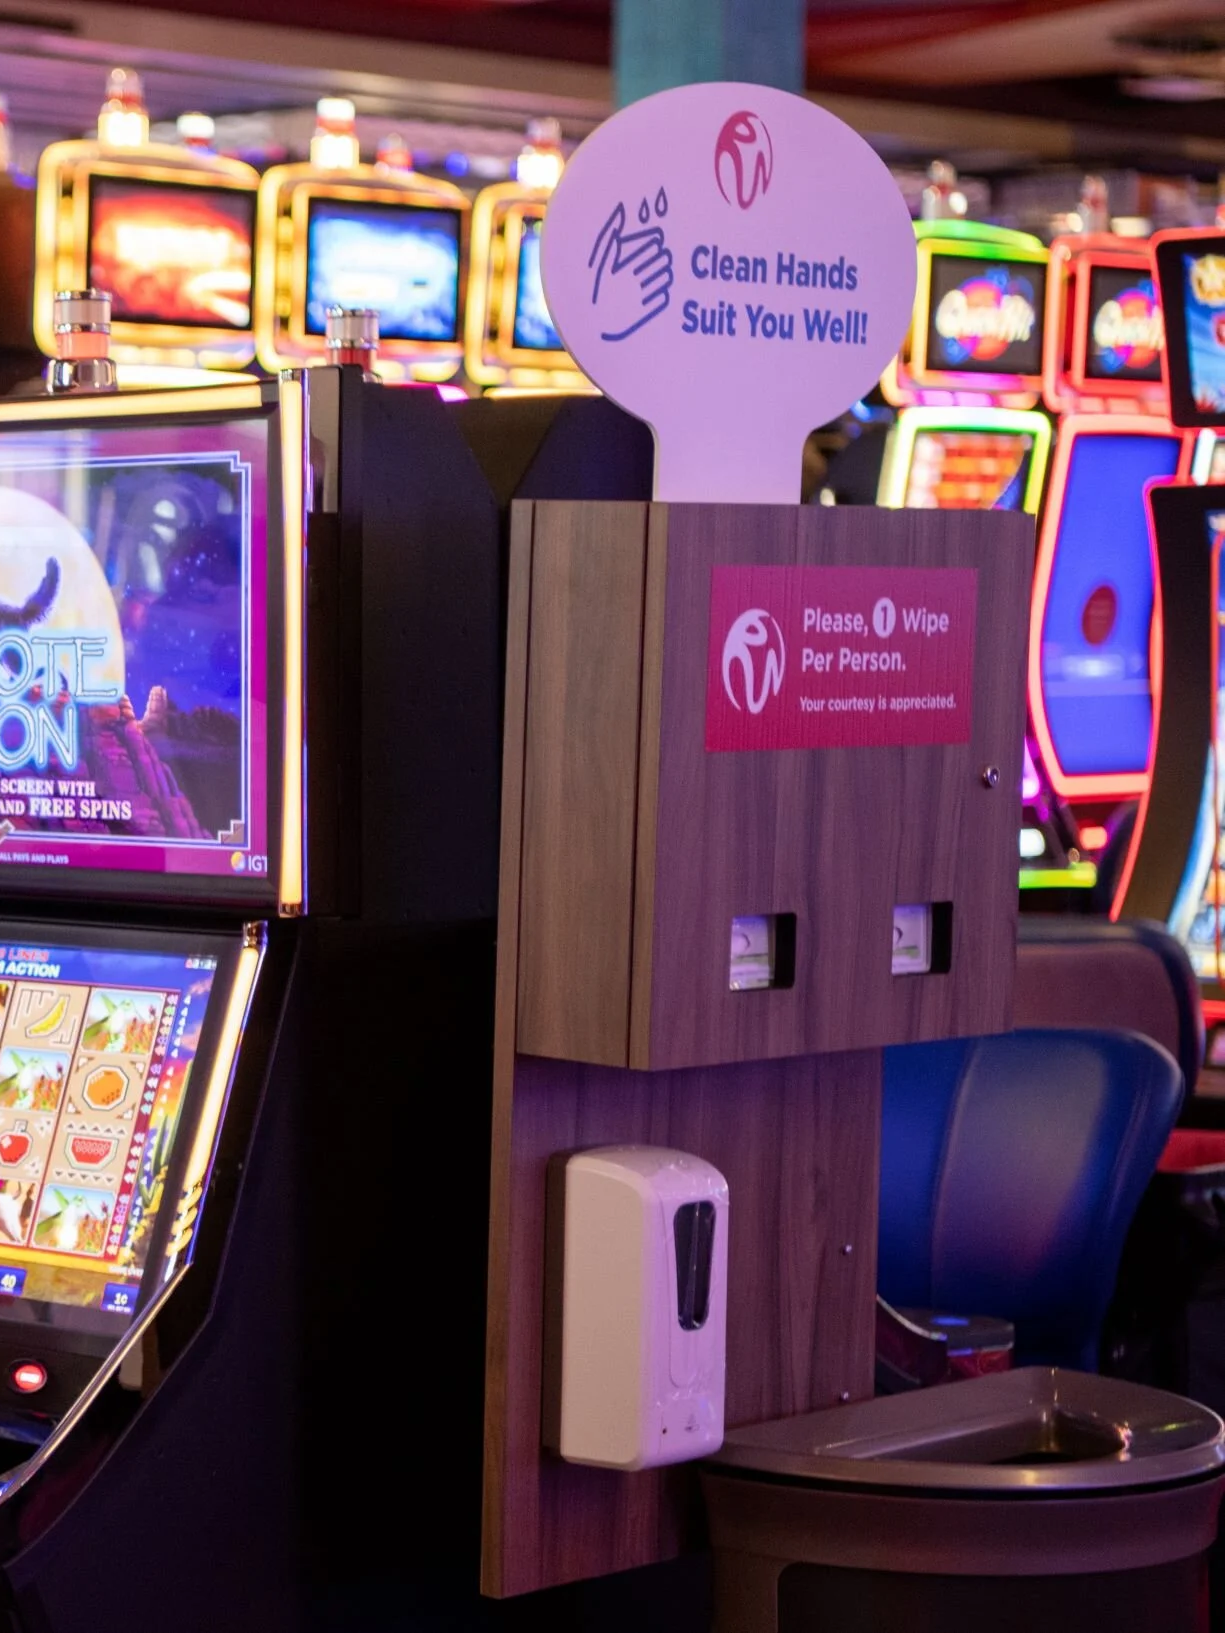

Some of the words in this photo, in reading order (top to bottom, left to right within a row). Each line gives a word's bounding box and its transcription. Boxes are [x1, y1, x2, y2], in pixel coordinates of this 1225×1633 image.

[691, 245, 767, 283] Clean
[776, 252, 858, 291] Hands
[682, 299, 736, 336] Suit
[745, 304, 794, 340] You
[803, 308, 868, 345] Well!
[803, 607, 869, 637] Please,
[902, 607, 949, 637] Wipe
[802, 648, 834, 673] Per
[839, 647, 906, 672] Person.
[800, 696, 825, 712] Your
[828, 696, 875, 713] courtesy
[878, 694, 886, 711] is
[890, 693, 956, 711] appreciated.
[1, 778, 54, 796] SCREEN
[58, 780, 96, 797] WITH
[29, 797, 76, 818] FREE
[79, 799, 132, 820] SPINS
[0, 852, 12, 862] ALL
[8, 948, 49, 962] LINES
[5, 961, 60, 978] ACTION
[0, 1273, 17, 1289] 40
